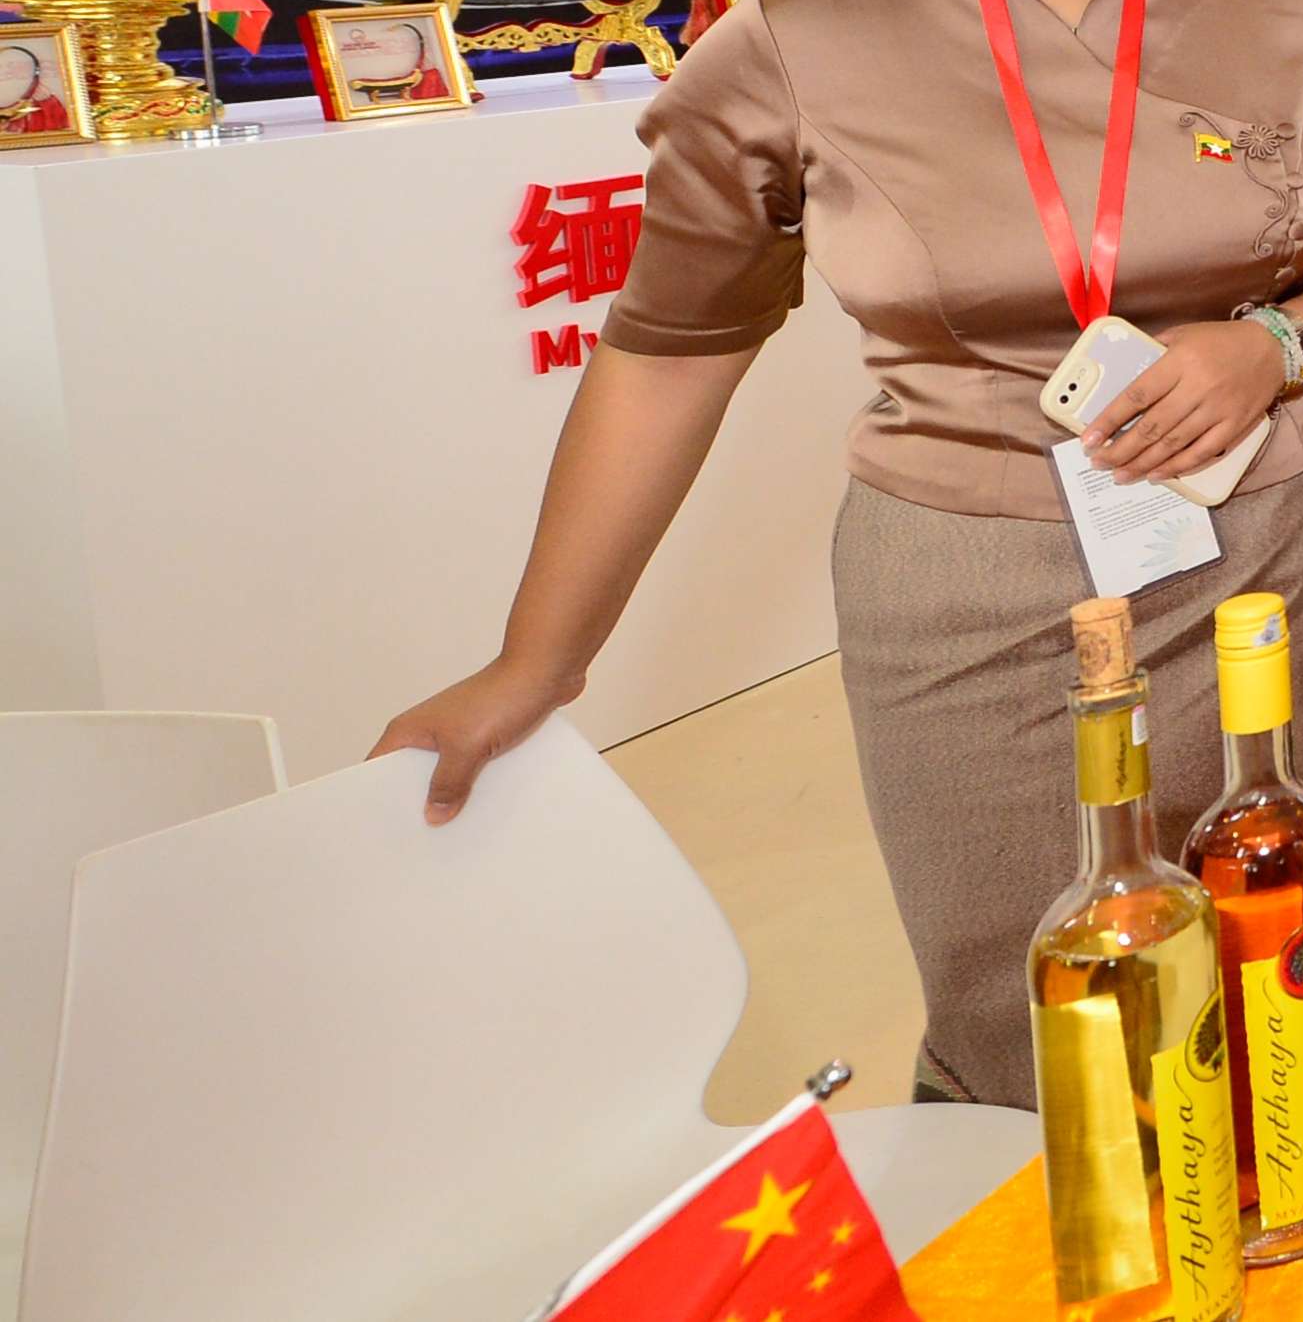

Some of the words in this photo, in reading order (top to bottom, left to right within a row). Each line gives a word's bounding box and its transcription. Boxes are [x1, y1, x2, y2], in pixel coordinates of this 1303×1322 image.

[509, 173, 645, 309] 缅
[1173, 1063, 1213, 1301] Aythaya
[1261, 976, 1302, 1201] Aythaya
